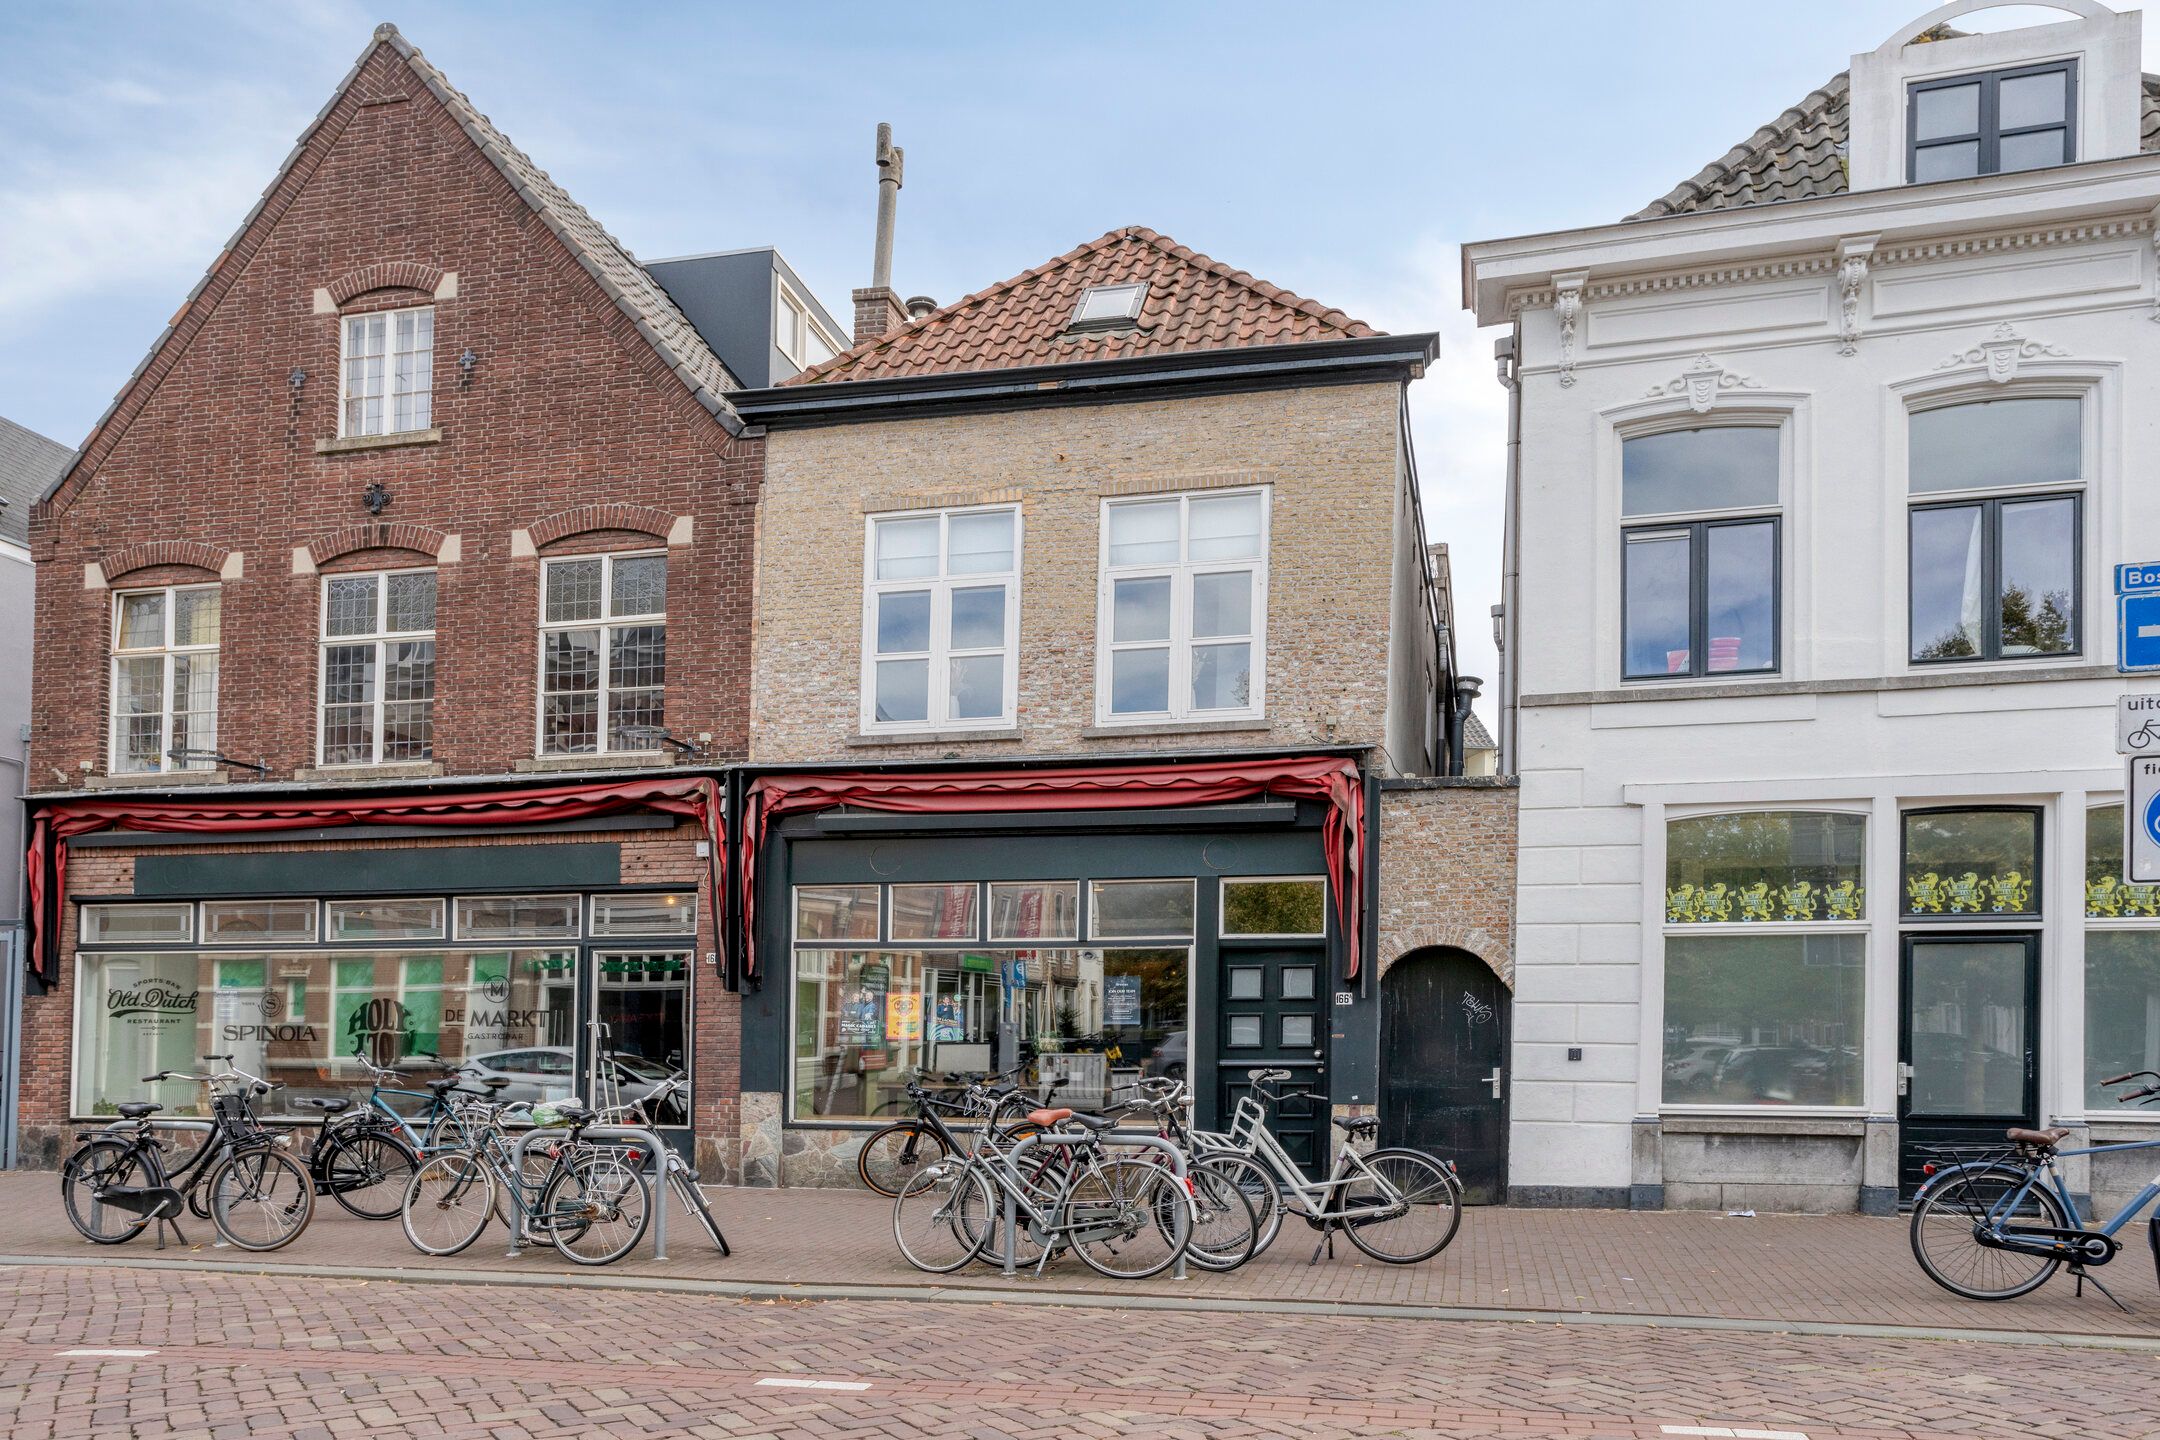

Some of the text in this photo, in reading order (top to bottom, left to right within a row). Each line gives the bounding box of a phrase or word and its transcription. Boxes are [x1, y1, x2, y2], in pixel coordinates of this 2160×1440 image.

[2144, 764, 2160, 775] fi
[132, 978, 182, 990] SPORTS BAR
[107, 988, 141, 1009] Old
[140, 988, 199, 1010] Dutch
[347, 998, 412, 1035] HOLY
[445, 1009, 549, 1028] DE MARKT
[223, 1025, 317, 1041] SPINOLA
[467, 1032, 524, 1041] GASTROBAR
